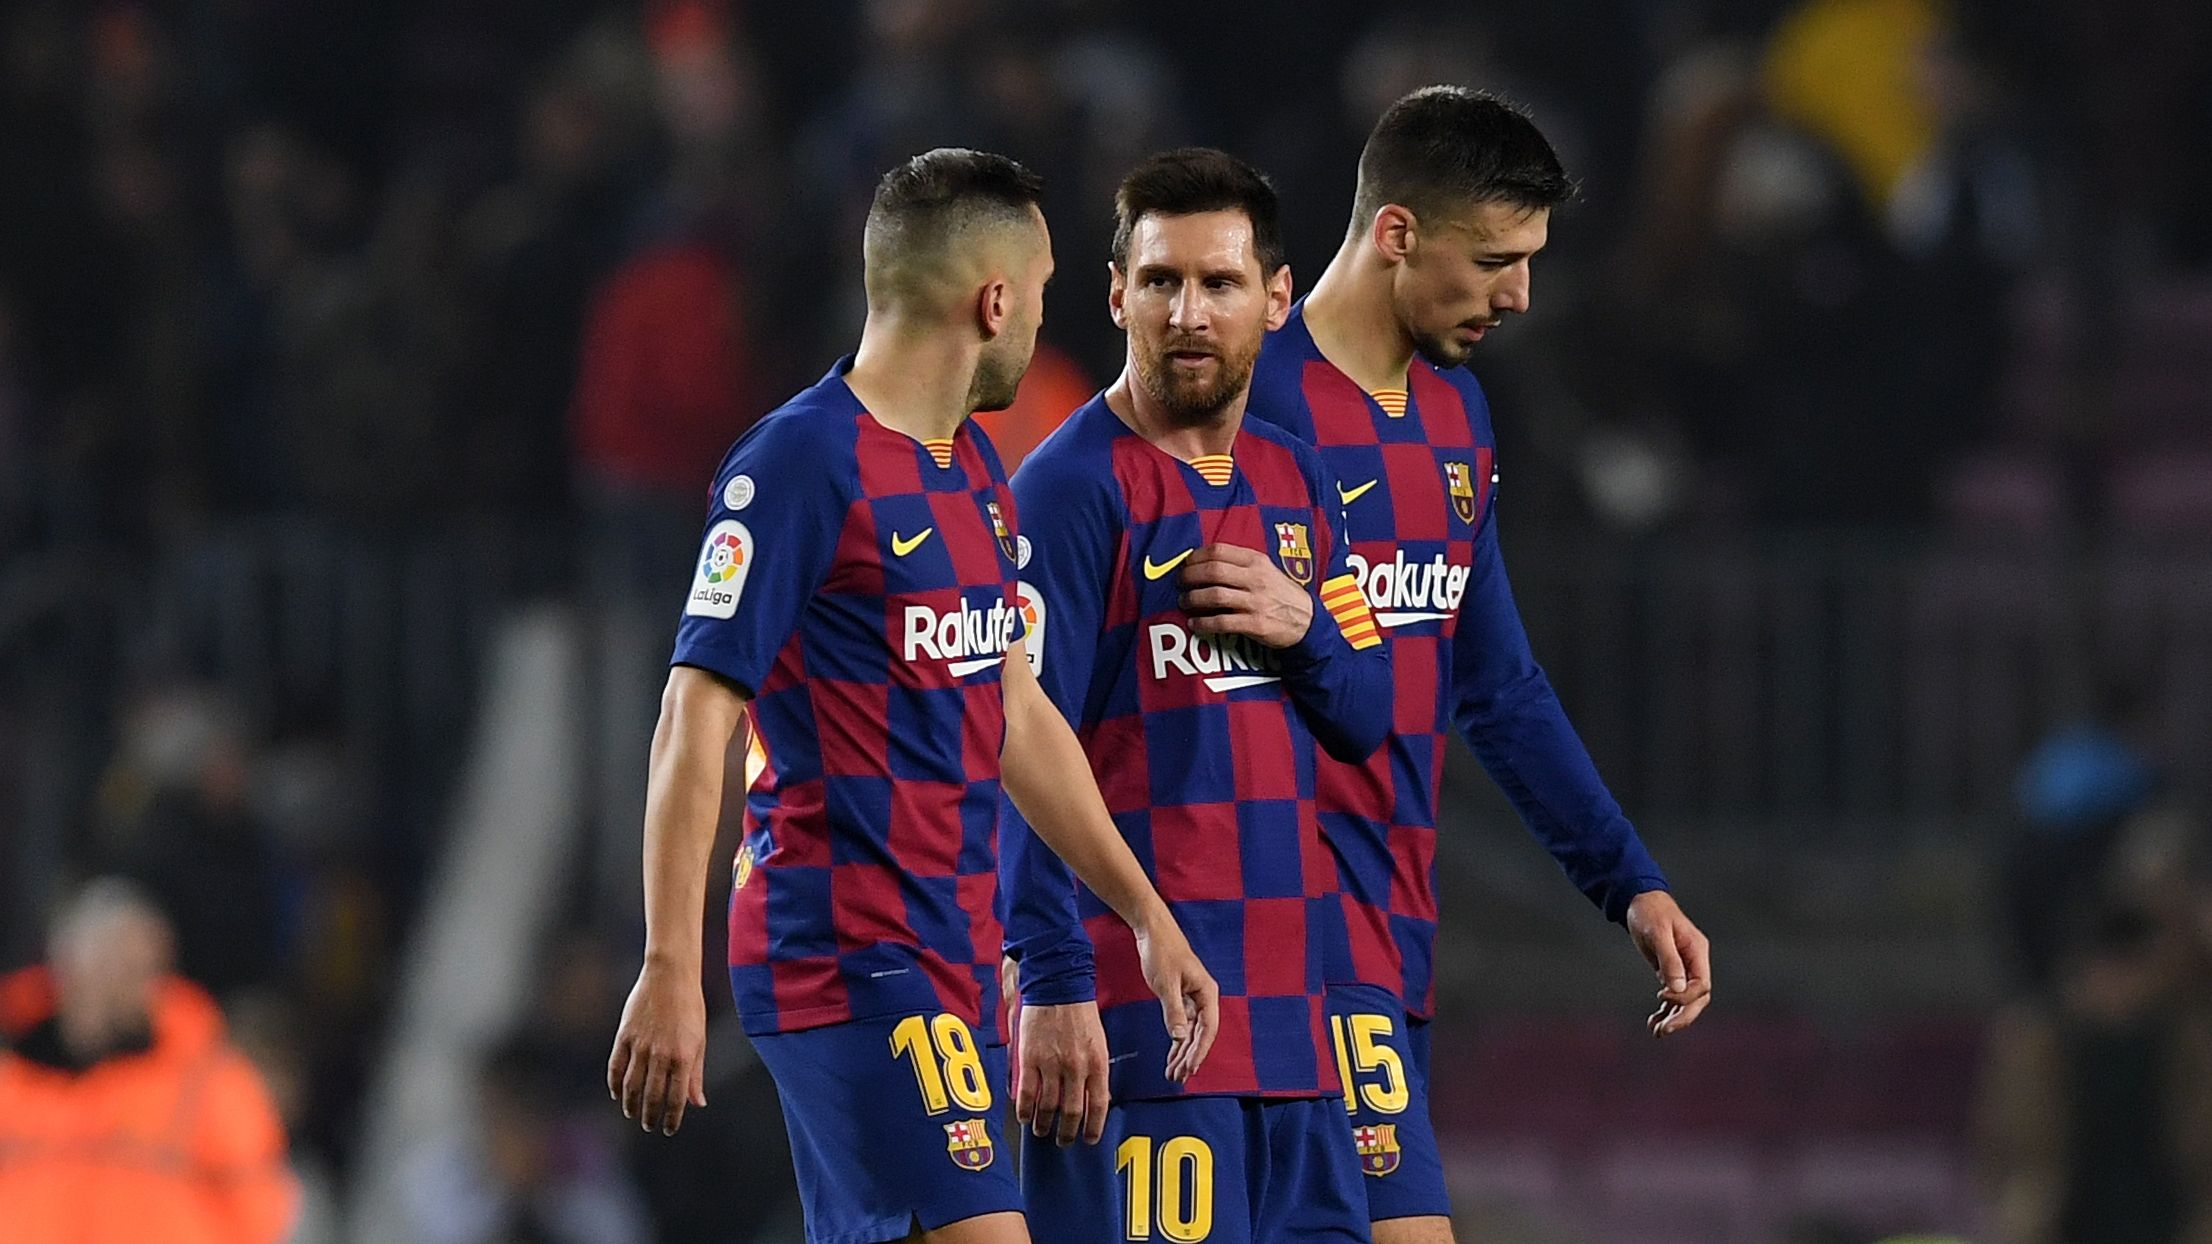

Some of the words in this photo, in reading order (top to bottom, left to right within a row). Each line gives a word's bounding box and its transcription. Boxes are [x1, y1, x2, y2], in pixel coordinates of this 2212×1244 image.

[693, 587, 733, 605] LaLiga
[888, 1013, 992, 1117] 18
[1114, 1135, 1213, 1244] 10
